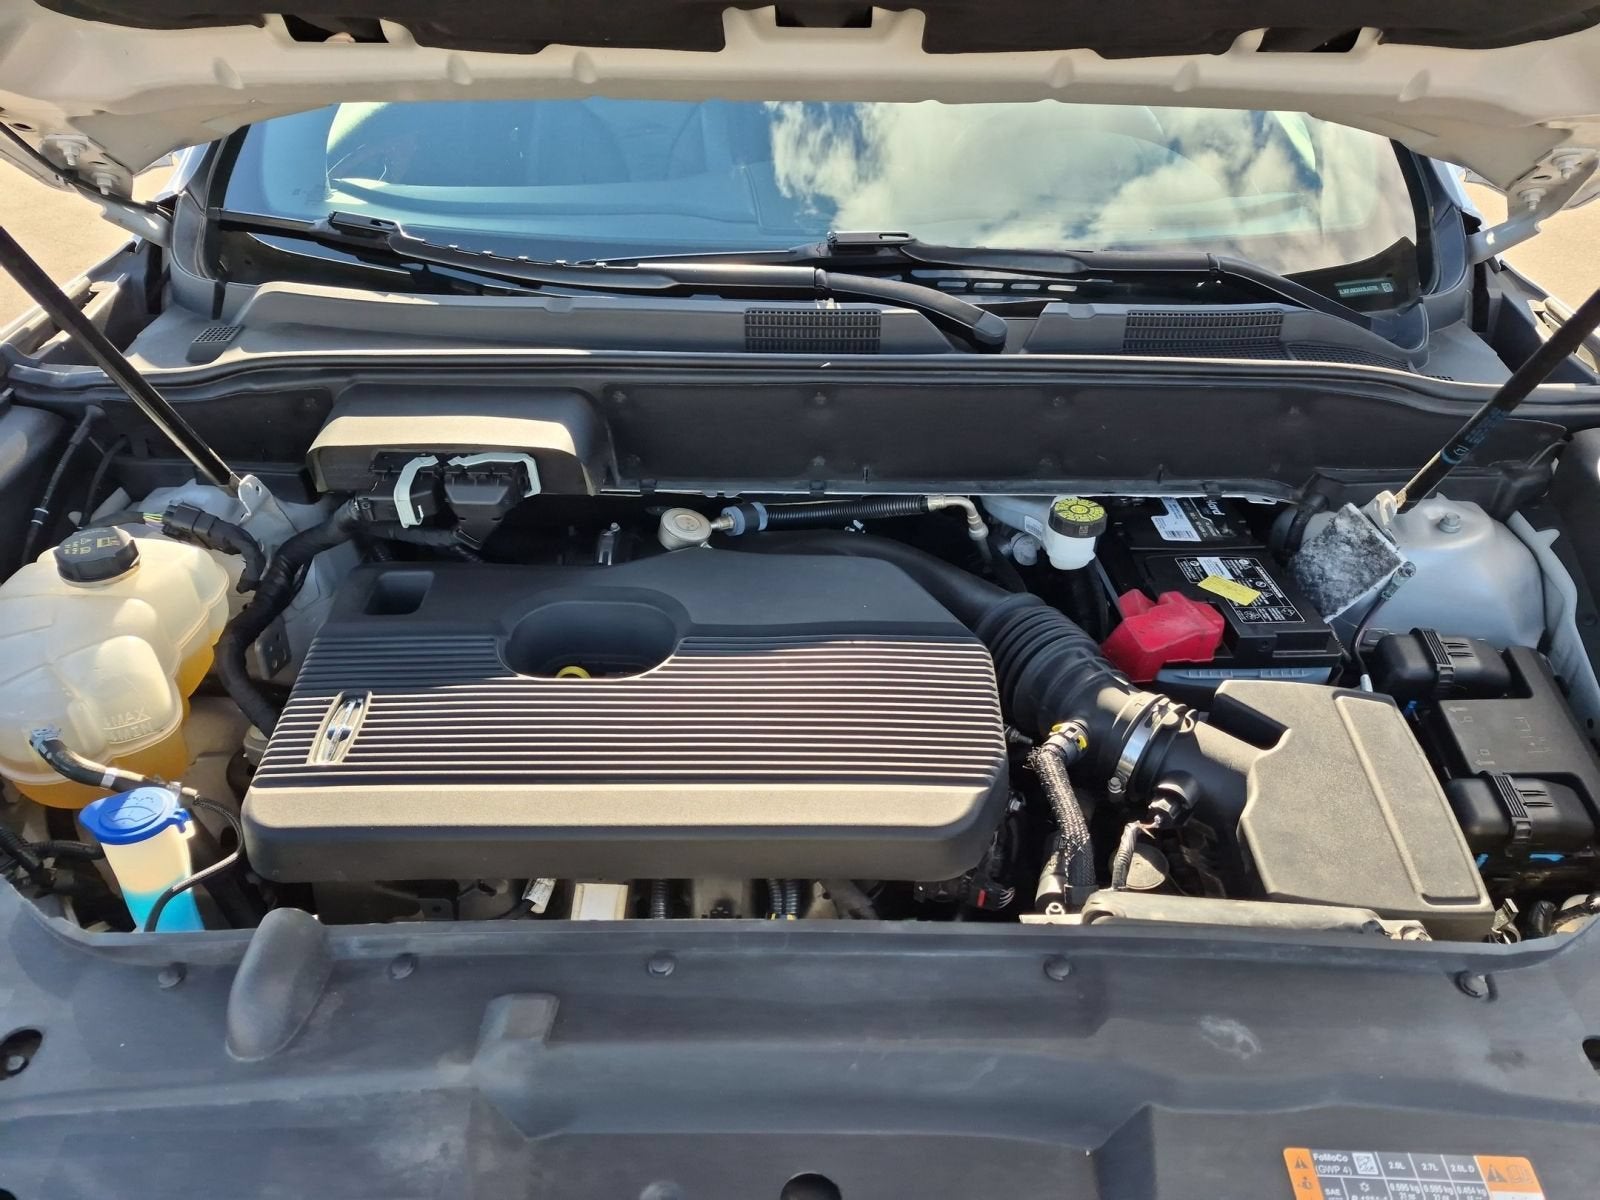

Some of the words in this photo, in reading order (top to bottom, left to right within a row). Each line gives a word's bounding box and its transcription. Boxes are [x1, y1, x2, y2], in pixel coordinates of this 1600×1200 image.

[1313, 1152, 1349, 1163] FoMoCo
[1421, 1162, 1439, 1171] 2.7L
[1409, 1183, 1421, 1194] kg
[1443, 1185, 1454, 1196] kg
[1476, 1186, 1487, 1197] kg
